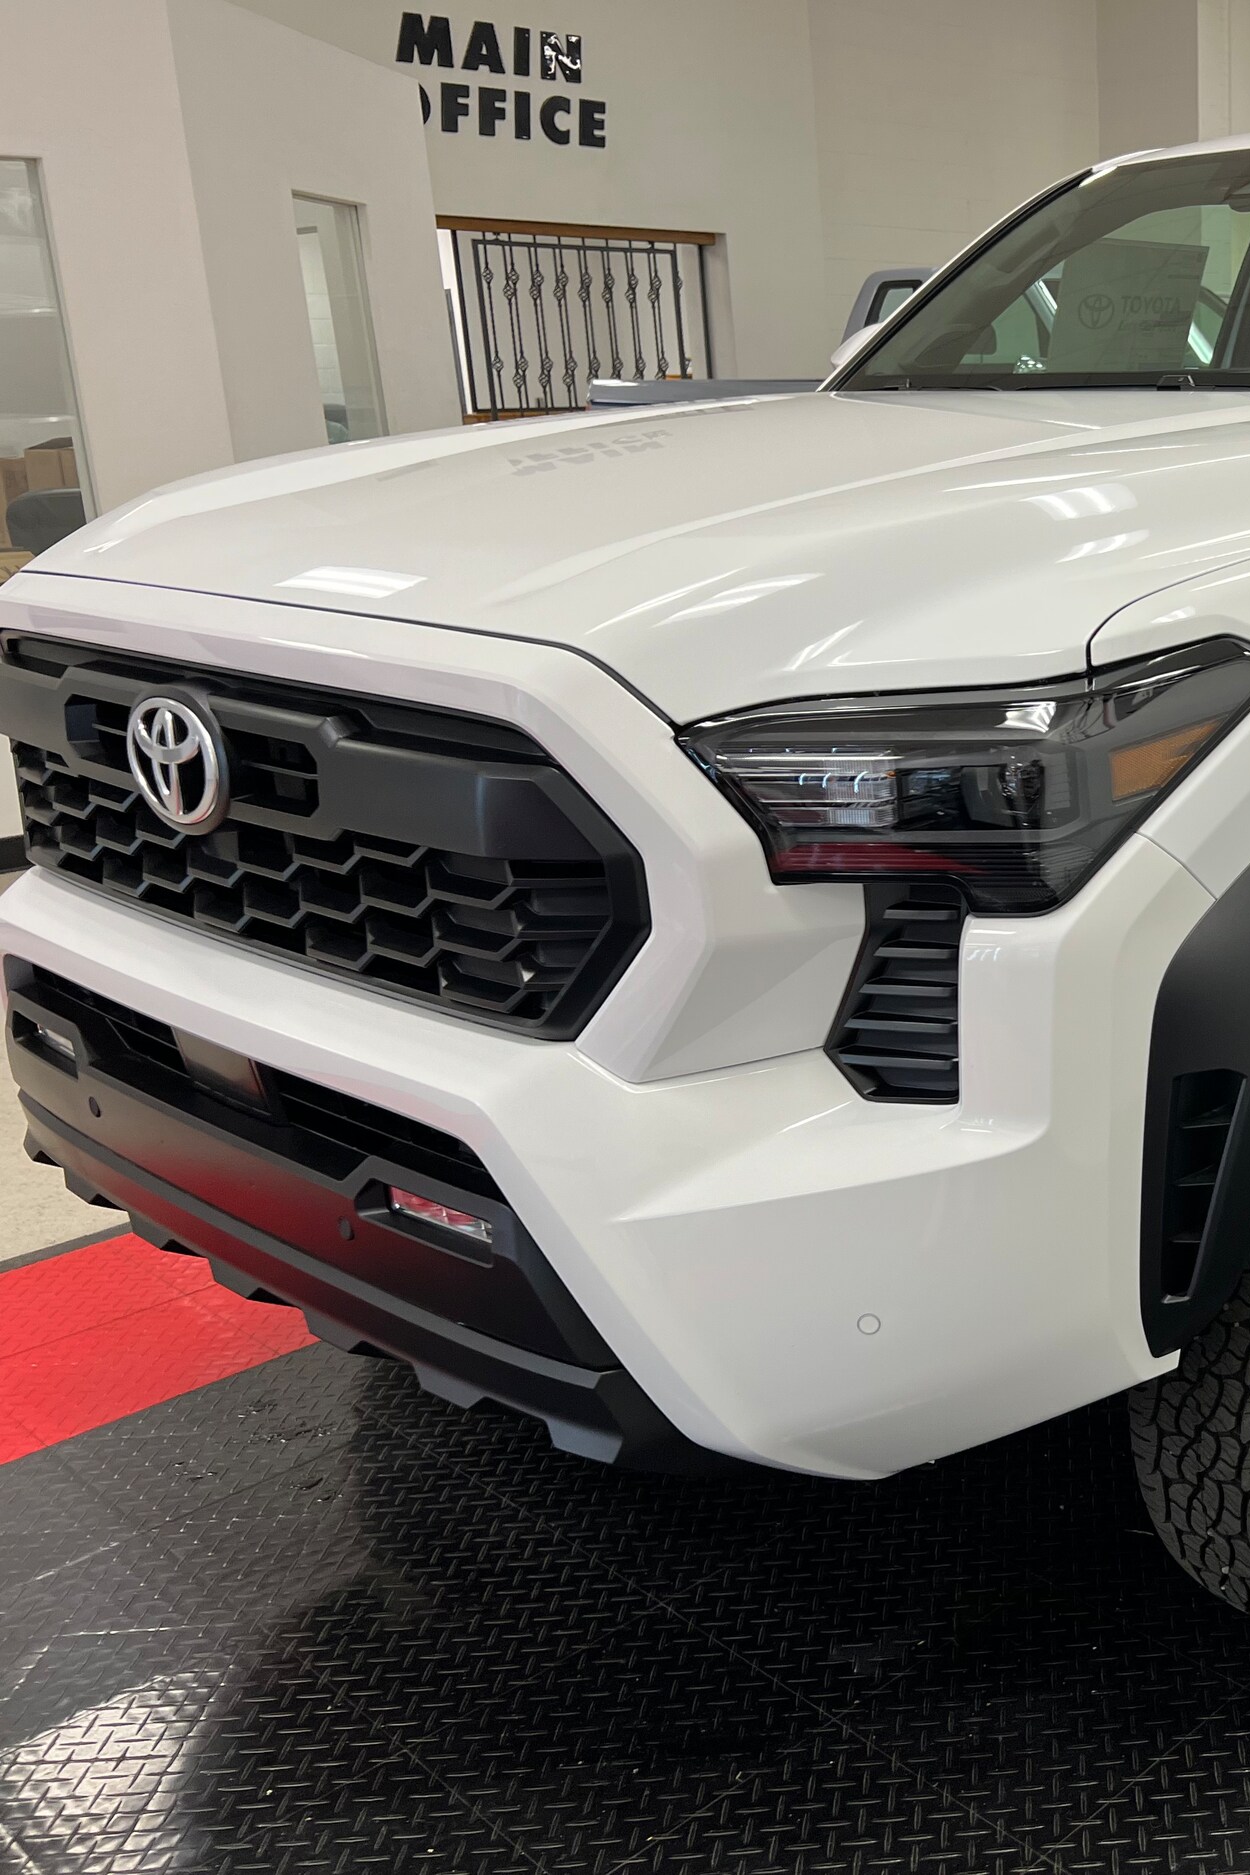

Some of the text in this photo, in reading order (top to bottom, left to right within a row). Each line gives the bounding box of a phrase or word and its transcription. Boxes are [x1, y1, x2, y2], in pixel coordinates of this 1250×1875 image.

[396, 12, 582, 83] MAIN
[419, 82, 606, 148] FFICE
[1121, 296, 1181, 315] TOYOTA
